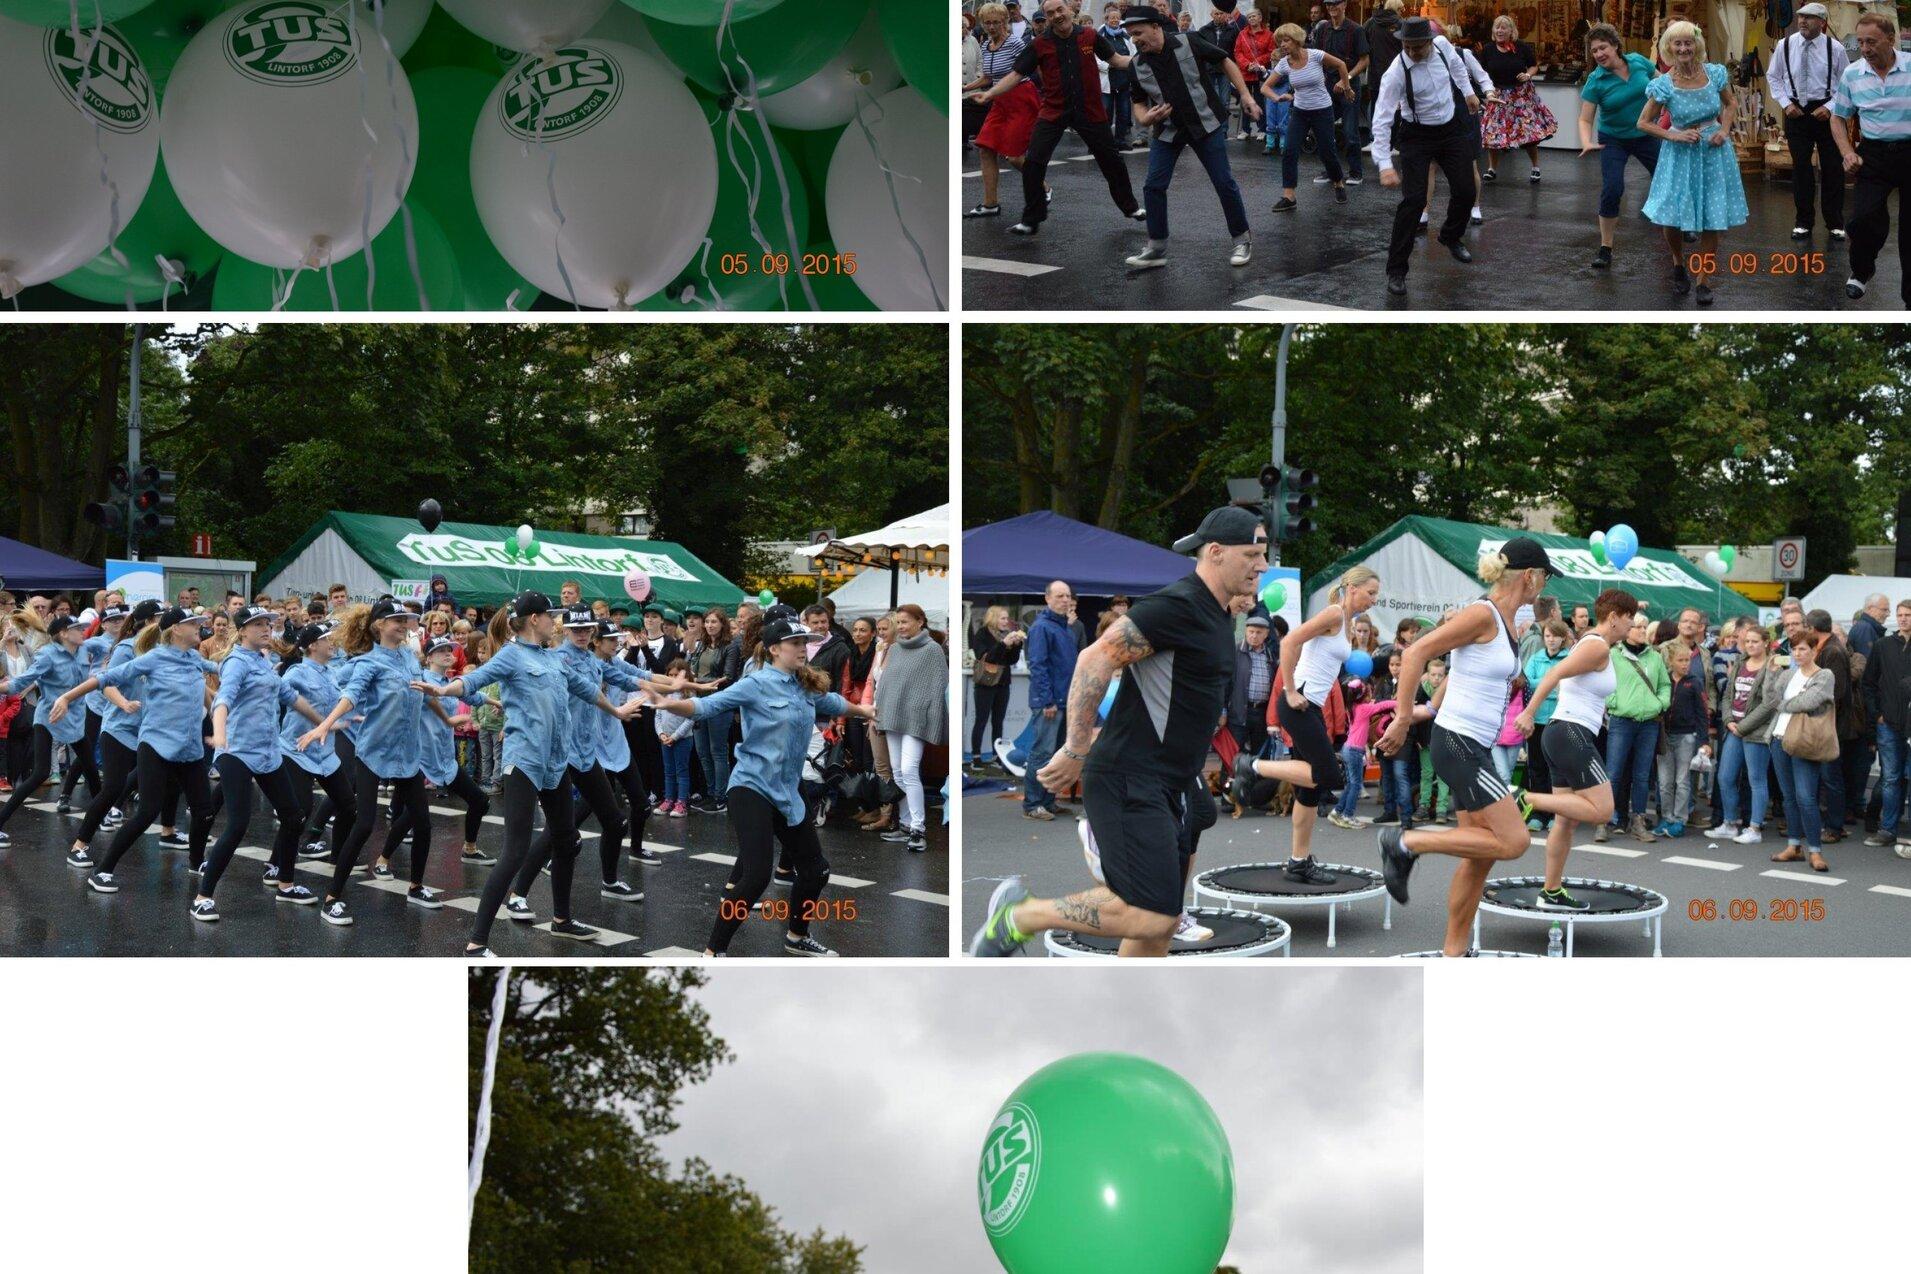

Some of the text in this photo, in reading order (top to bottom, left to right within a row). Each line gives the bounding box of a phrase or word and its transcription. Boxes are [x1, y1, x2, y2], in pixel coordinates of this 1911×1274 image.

[237, 16, 348, 50] TUS
[267, 51, 342, 74] LINTORF 1908
[116, 109, 138, 119] 1908
[578, 93, 604, 116] 1908
[1784, 549, 1795, 562] 30
